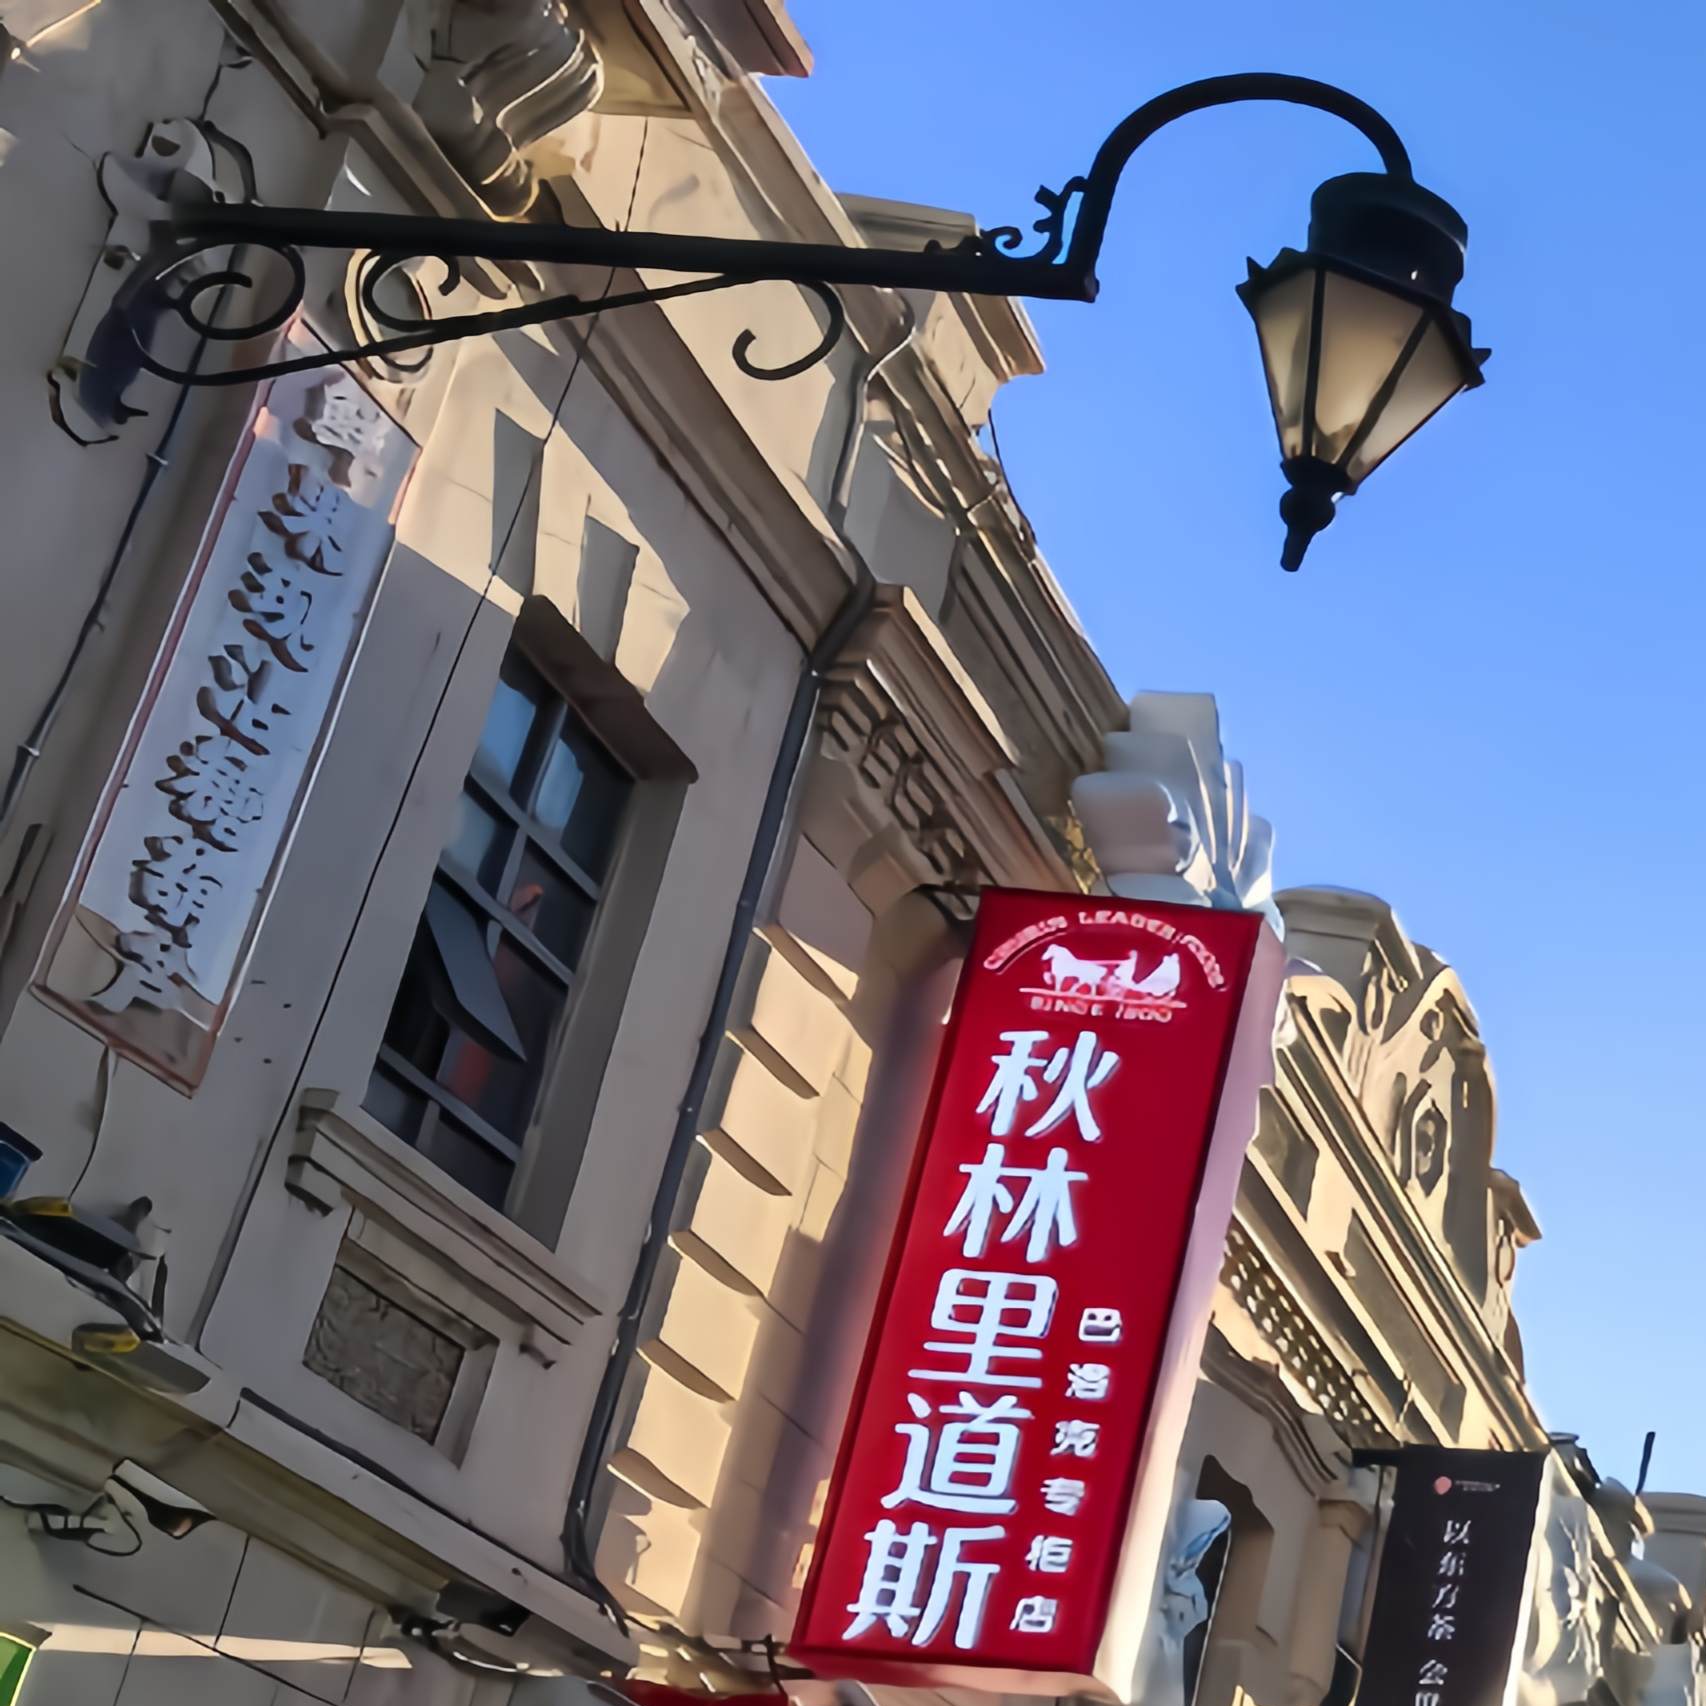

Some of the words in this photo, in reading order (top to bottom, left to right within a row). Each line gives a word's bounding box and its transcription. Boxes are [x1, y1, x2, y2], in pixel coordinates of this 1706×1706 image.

[842, 1029, 1122, 1651] 秋林里道斯
